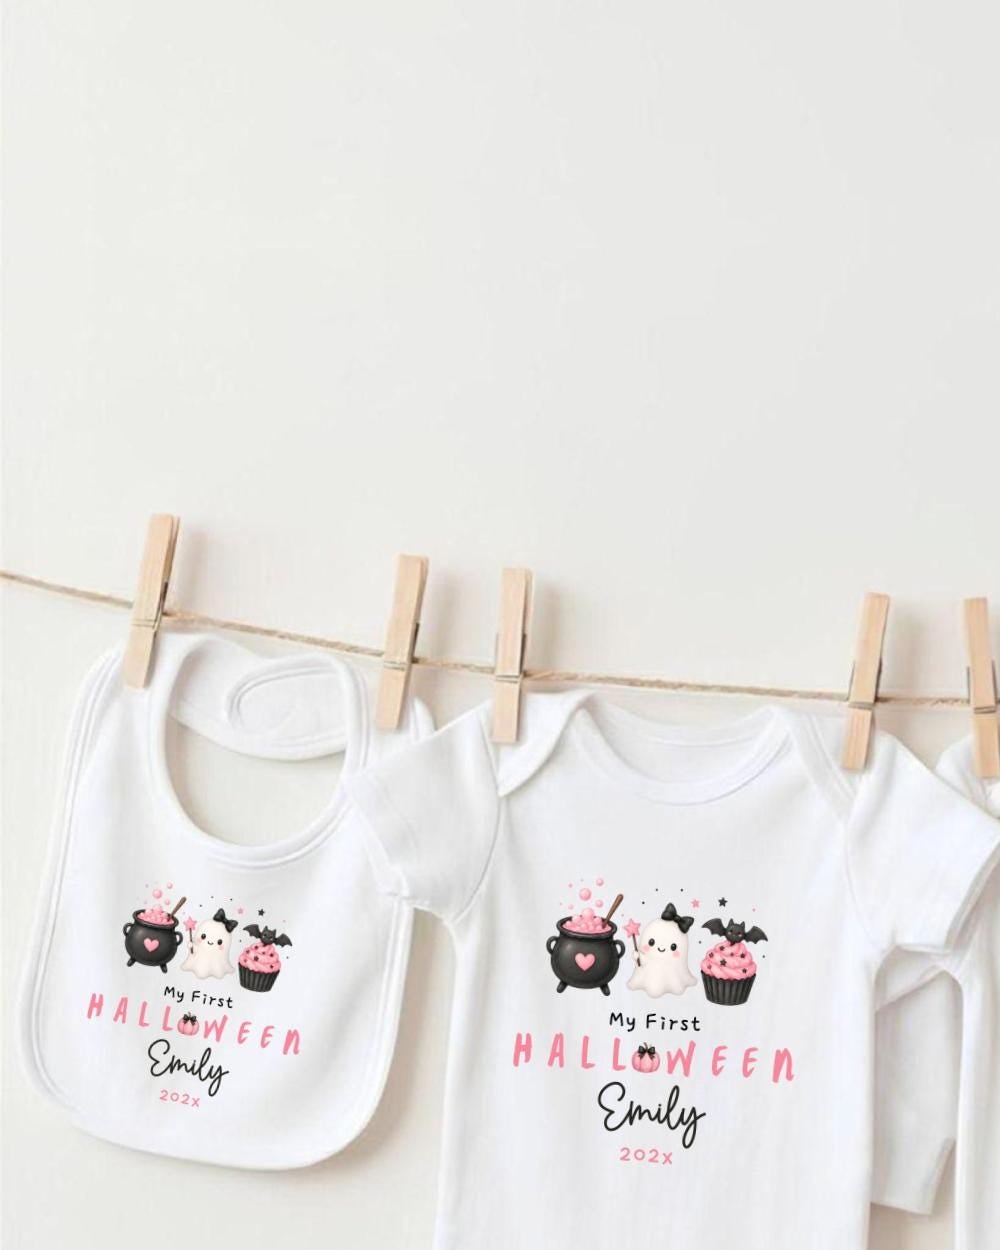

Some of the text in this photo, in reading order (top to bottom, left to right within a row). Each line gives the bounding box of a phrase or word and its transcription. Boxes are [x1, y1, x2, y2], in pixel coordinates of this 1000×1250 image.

[164, 985, 233, 1009] My First
[609, 1012, 701, 1033] My First
[147, 1038, 230, 1097] Emily
[597, 1081, 707, 1150] Emily
